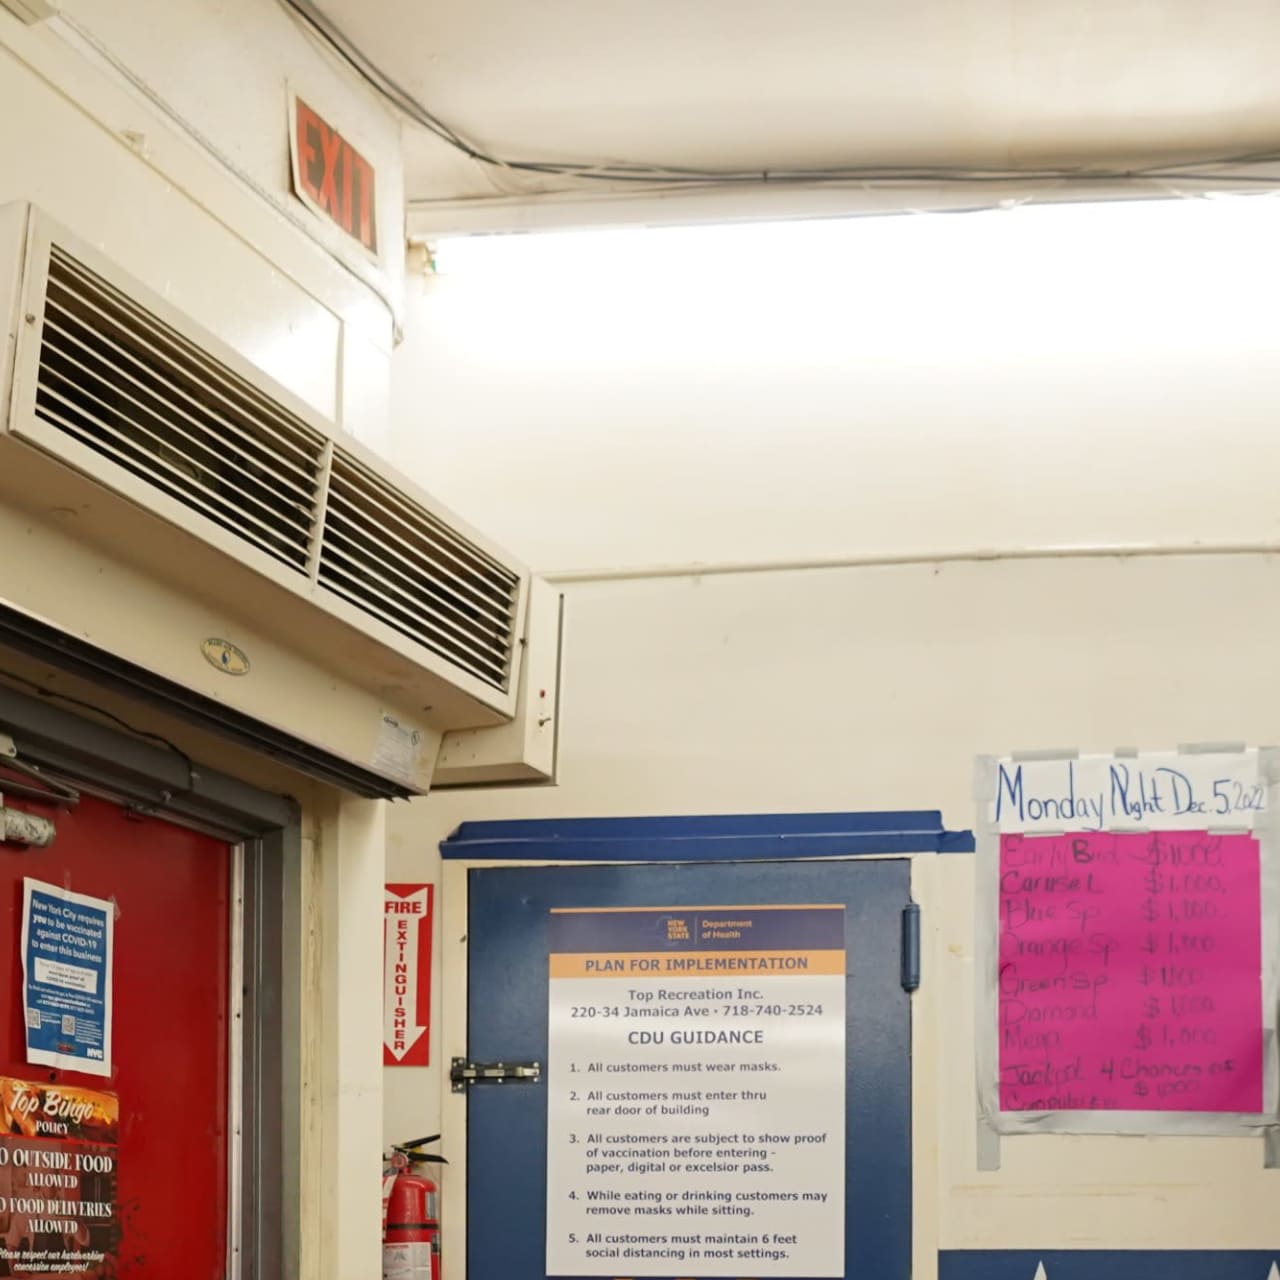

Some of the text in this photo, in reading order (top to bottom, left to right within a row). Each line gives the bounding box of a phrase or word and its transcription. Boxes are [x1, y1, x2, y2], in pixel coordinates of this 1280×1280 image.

[296, 100, 375, 250] EXIT
[996, 761, 1104, 831] Monday
[1110, 764, 1165, 819] Night
[1156, 768, 1212, 815] Dec.
[384, 901, 422, 914] FIRE
[702, 919, 752, 930] Department
[702, 930, 741, 939] of Health
[585, 957, 808, 972] PLAN FOR IMPLEMENTATION
[394, 919, 408, 1050] EXTINGUISHER
[628, 988, 764, 1002] Top Recreation Inc.
[571, 1004, 823, 1018] 220-34 Jamaica Ave 718-740-2524
[628, 1030, 764, 1045] CDU GUIDANCE
[570, 1062, 781, 1073] 1. All customers must wear masks.
[570, 1090, 767, 1101] 2. All customers must enter thru
[10, 1084, 94, 1124] Top Bingo
[586, 1105, 710, 1117] rear door of building
[35, 1120, 69, 1135] POLICY
[13, 1148, 72, 1170] OUTSIDE
[76, 1154, 112, 1173] FOOD
[26, 1173, 78, 1189] ALLOWED
[10, 1198, 44, 1214] FOOD
[47, 1199, 112, 1217] DELIVERIES
[26, 1219, 78, 1234] ALLOWED
[568, 1233, 797, 1244] 5. All customers must maintain 6 feet
[585, 1247, 790, 1261] social distancing in most settings.
